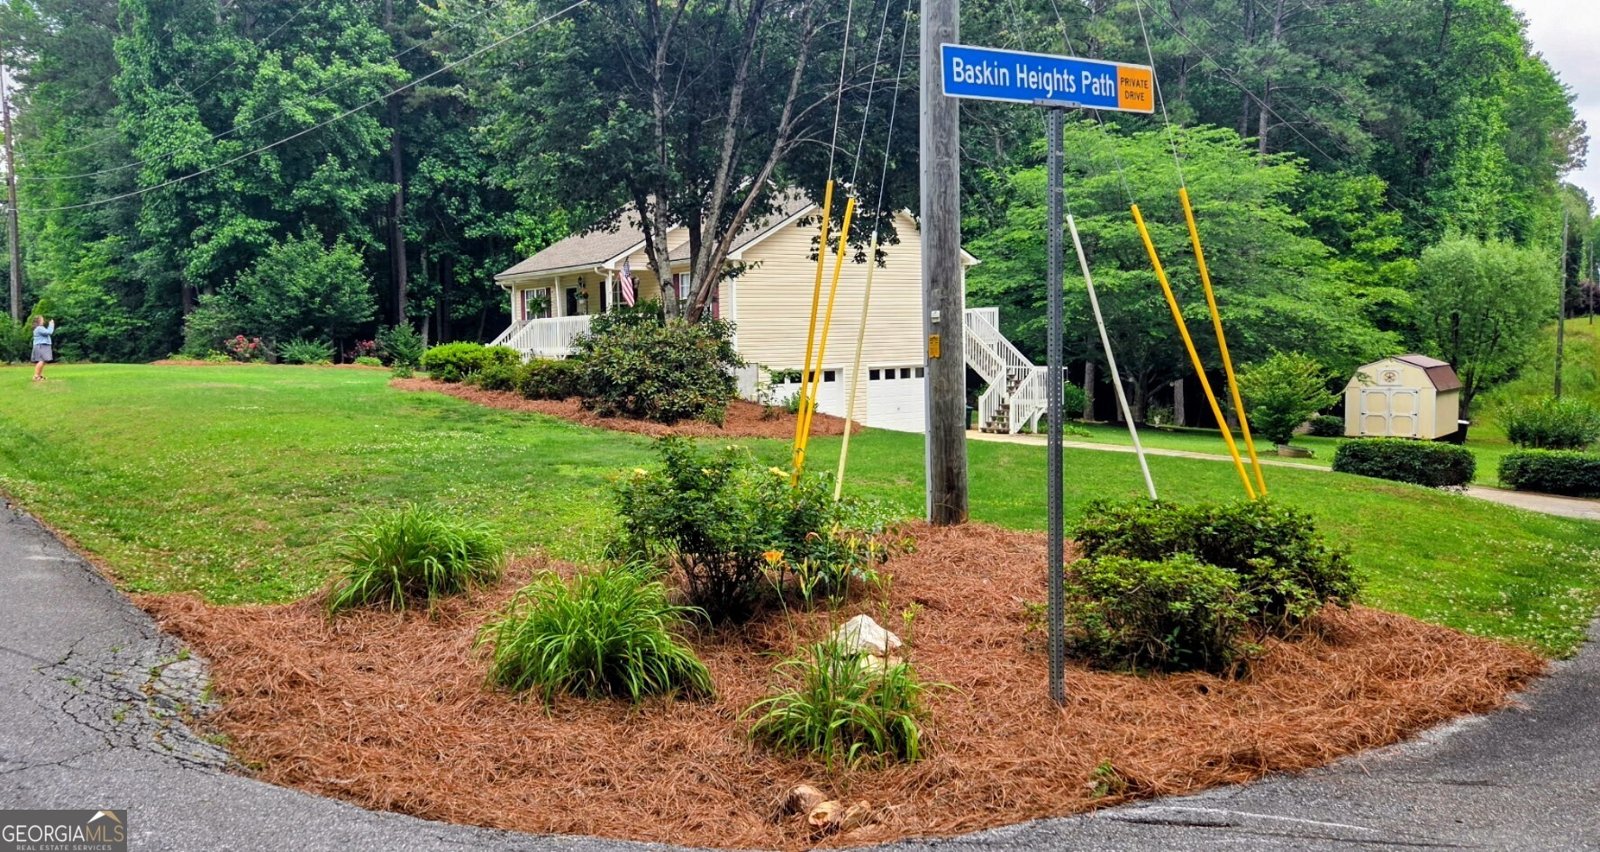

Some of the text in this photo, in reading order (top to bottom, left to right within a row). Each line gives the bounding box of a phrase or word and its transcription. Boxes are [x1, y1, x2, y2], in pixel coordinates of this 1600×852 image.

[952, 56, 1115, 98] Baskin Heights Path
[1120, 76, 1149, 89] PRIVATE
[1124, 90, 1145, 101] DRIVE
